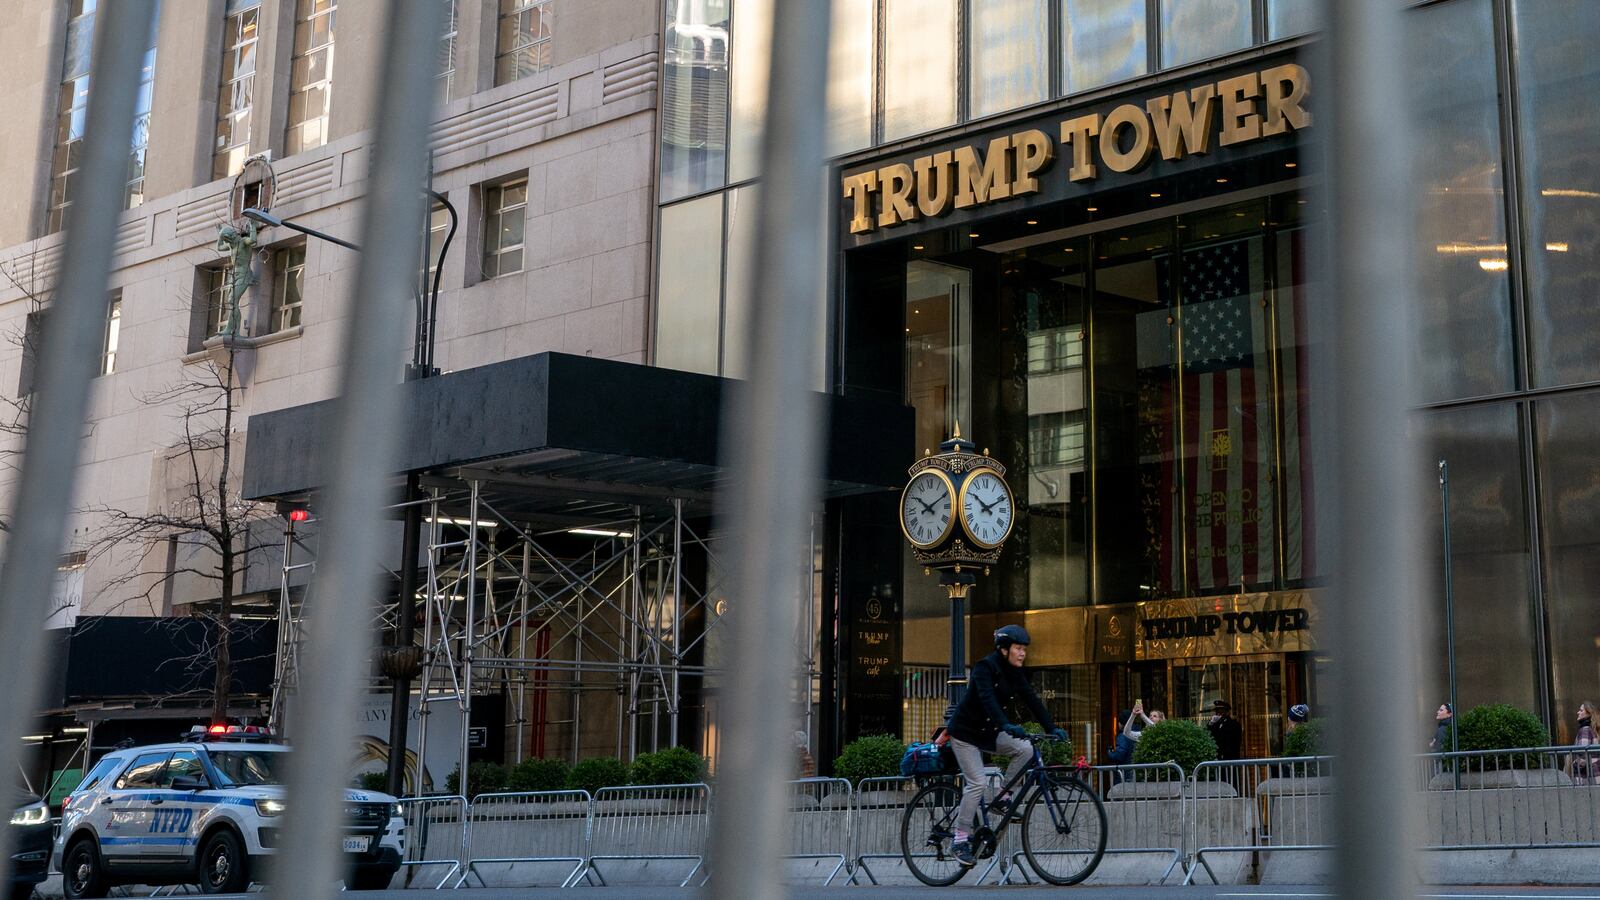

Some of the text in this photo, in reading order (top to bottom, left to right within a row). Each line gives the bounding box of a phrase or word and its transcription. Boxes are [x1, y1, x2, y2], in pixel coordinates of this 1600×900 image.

[843, 63, 1313, 234] TRUMP TOWER
[911, 458, 948, 473] TRUMP TOWER
[967, 457, 1003, 472] TRUMP TOWER
[1141, 608, 1310, 641] TRUMP TOWER
[858, 631, 889, 641] TRUMP
[858, 657, 889, 665] TRUMP
[149, 808, 193, 833] NYPD
